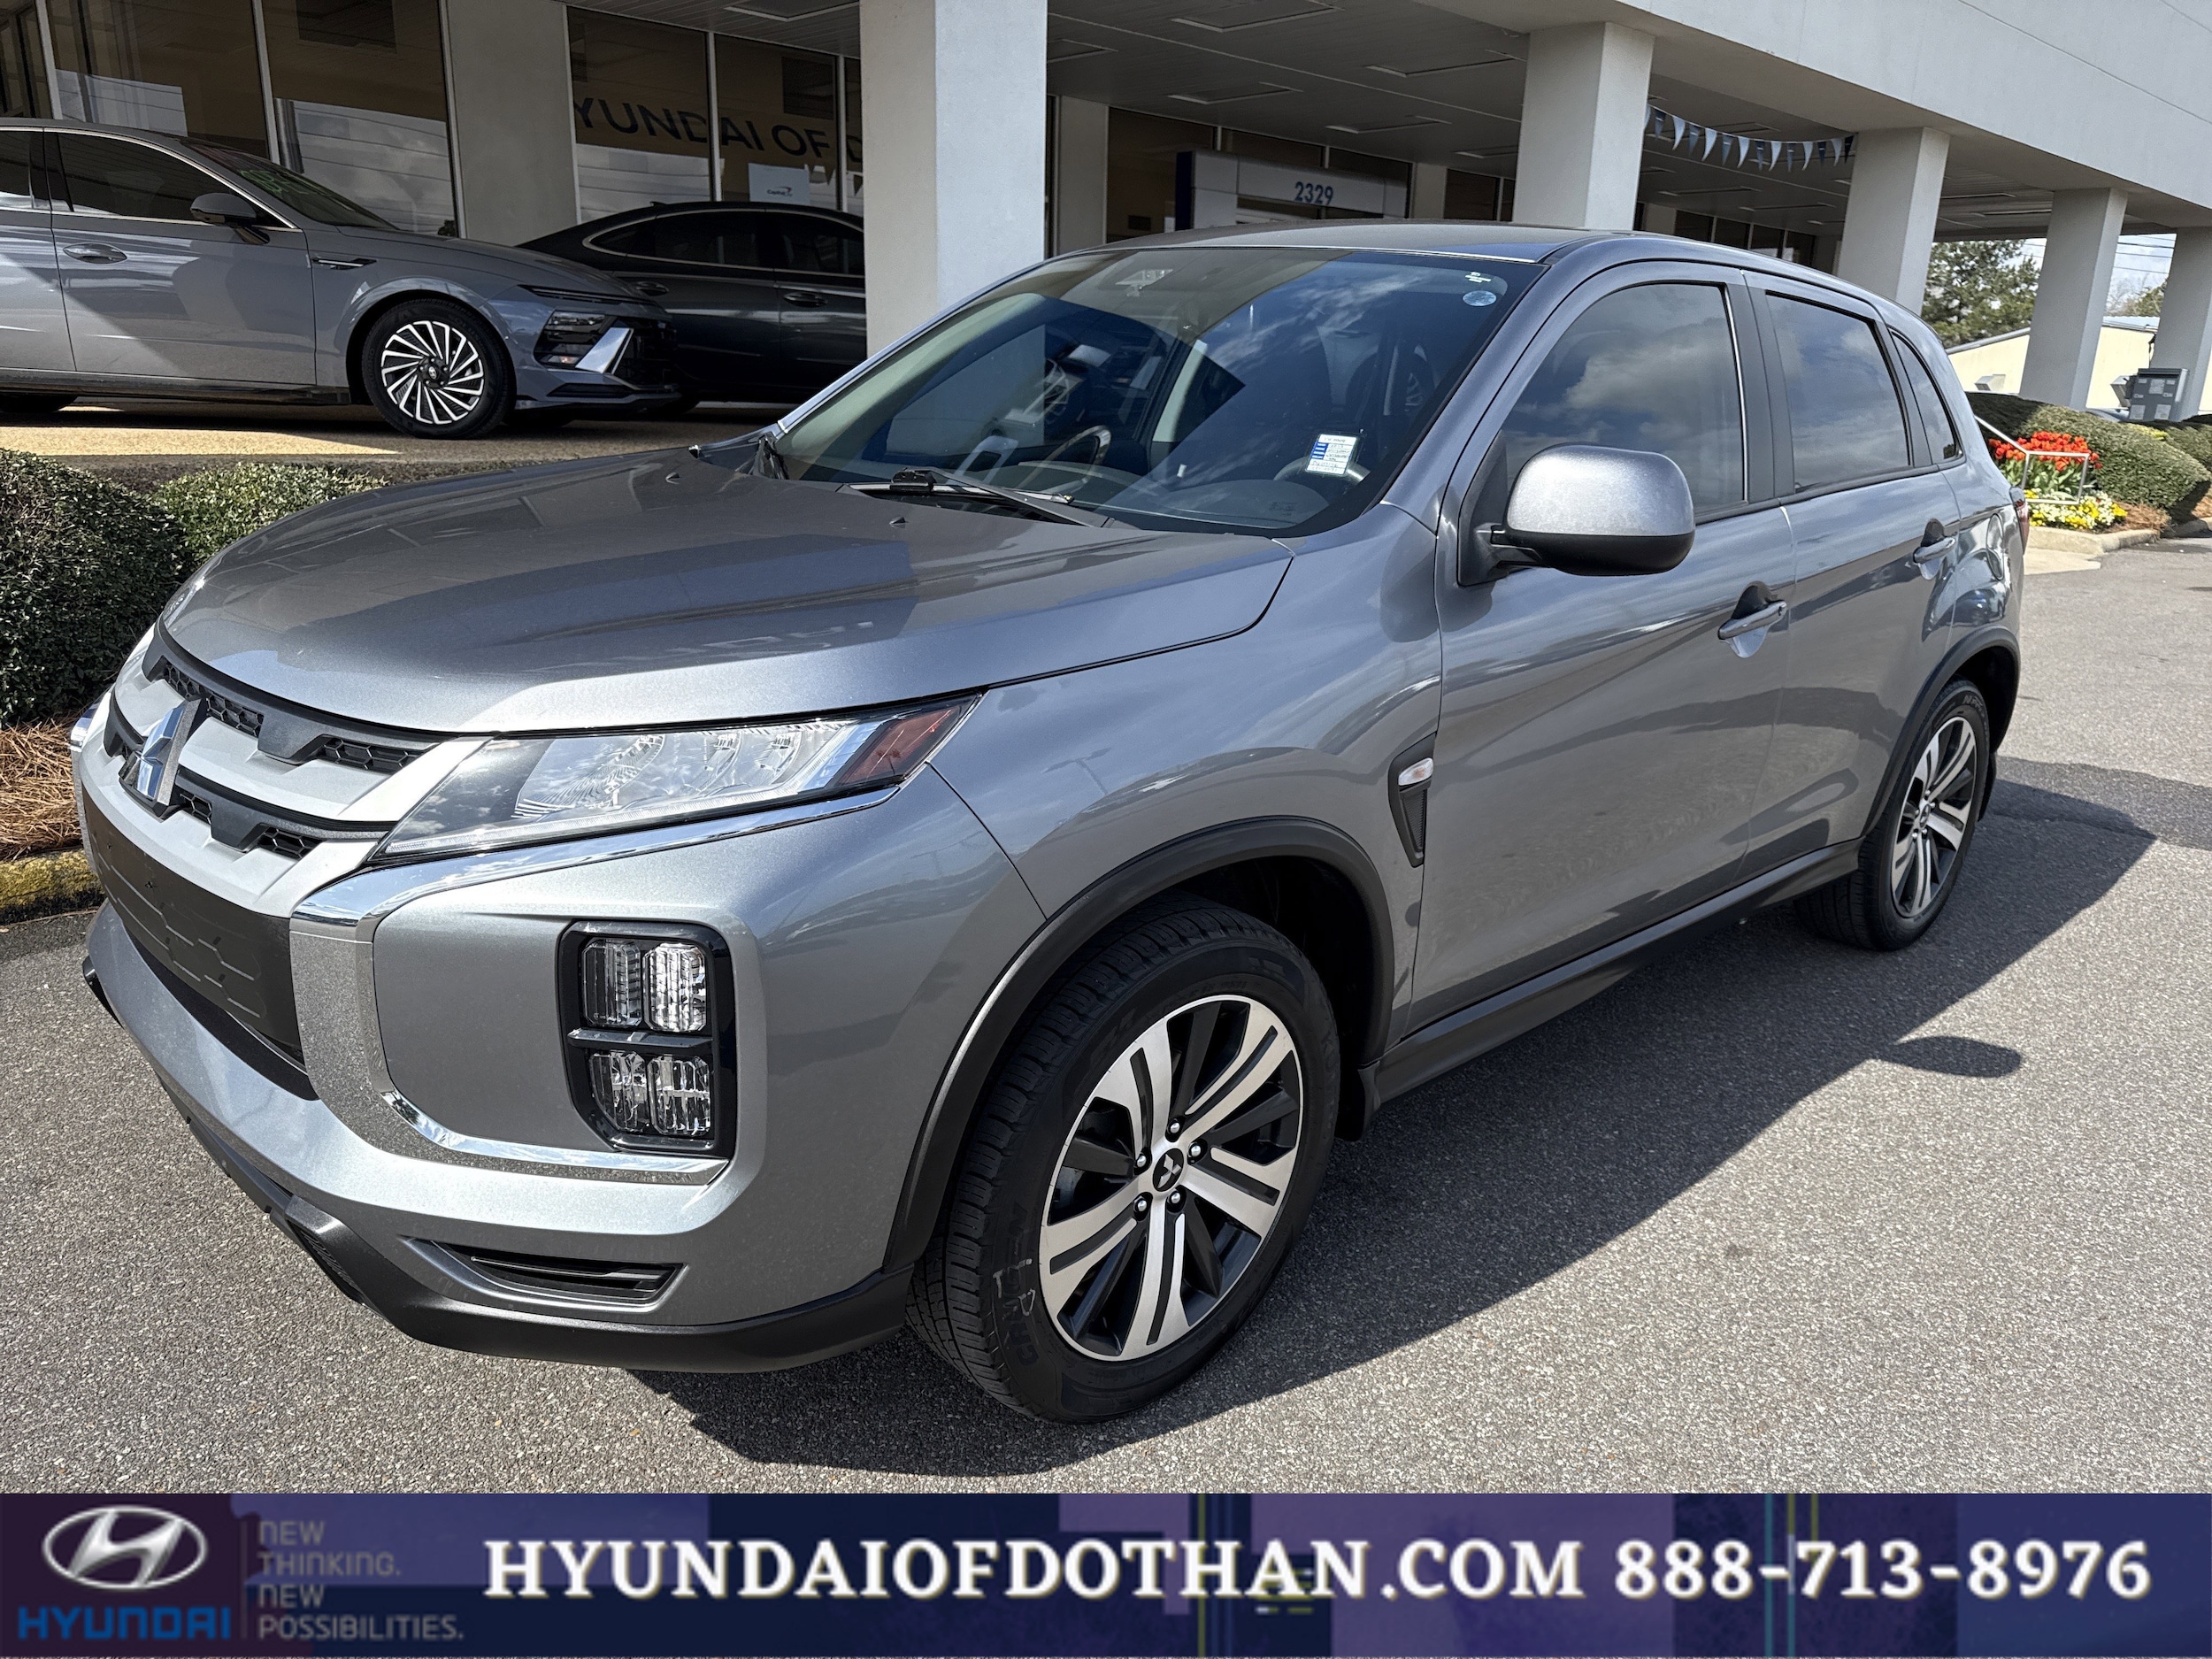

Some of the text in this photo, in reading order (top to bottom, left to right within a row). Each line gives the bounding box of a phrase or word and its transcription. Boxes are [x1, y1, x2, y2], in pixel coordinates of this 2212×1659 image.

[575, 97, 764, 151] YUNDAI
[771, 124, 831, 158] OF
[1294, 180, 1334, 205] 2329
